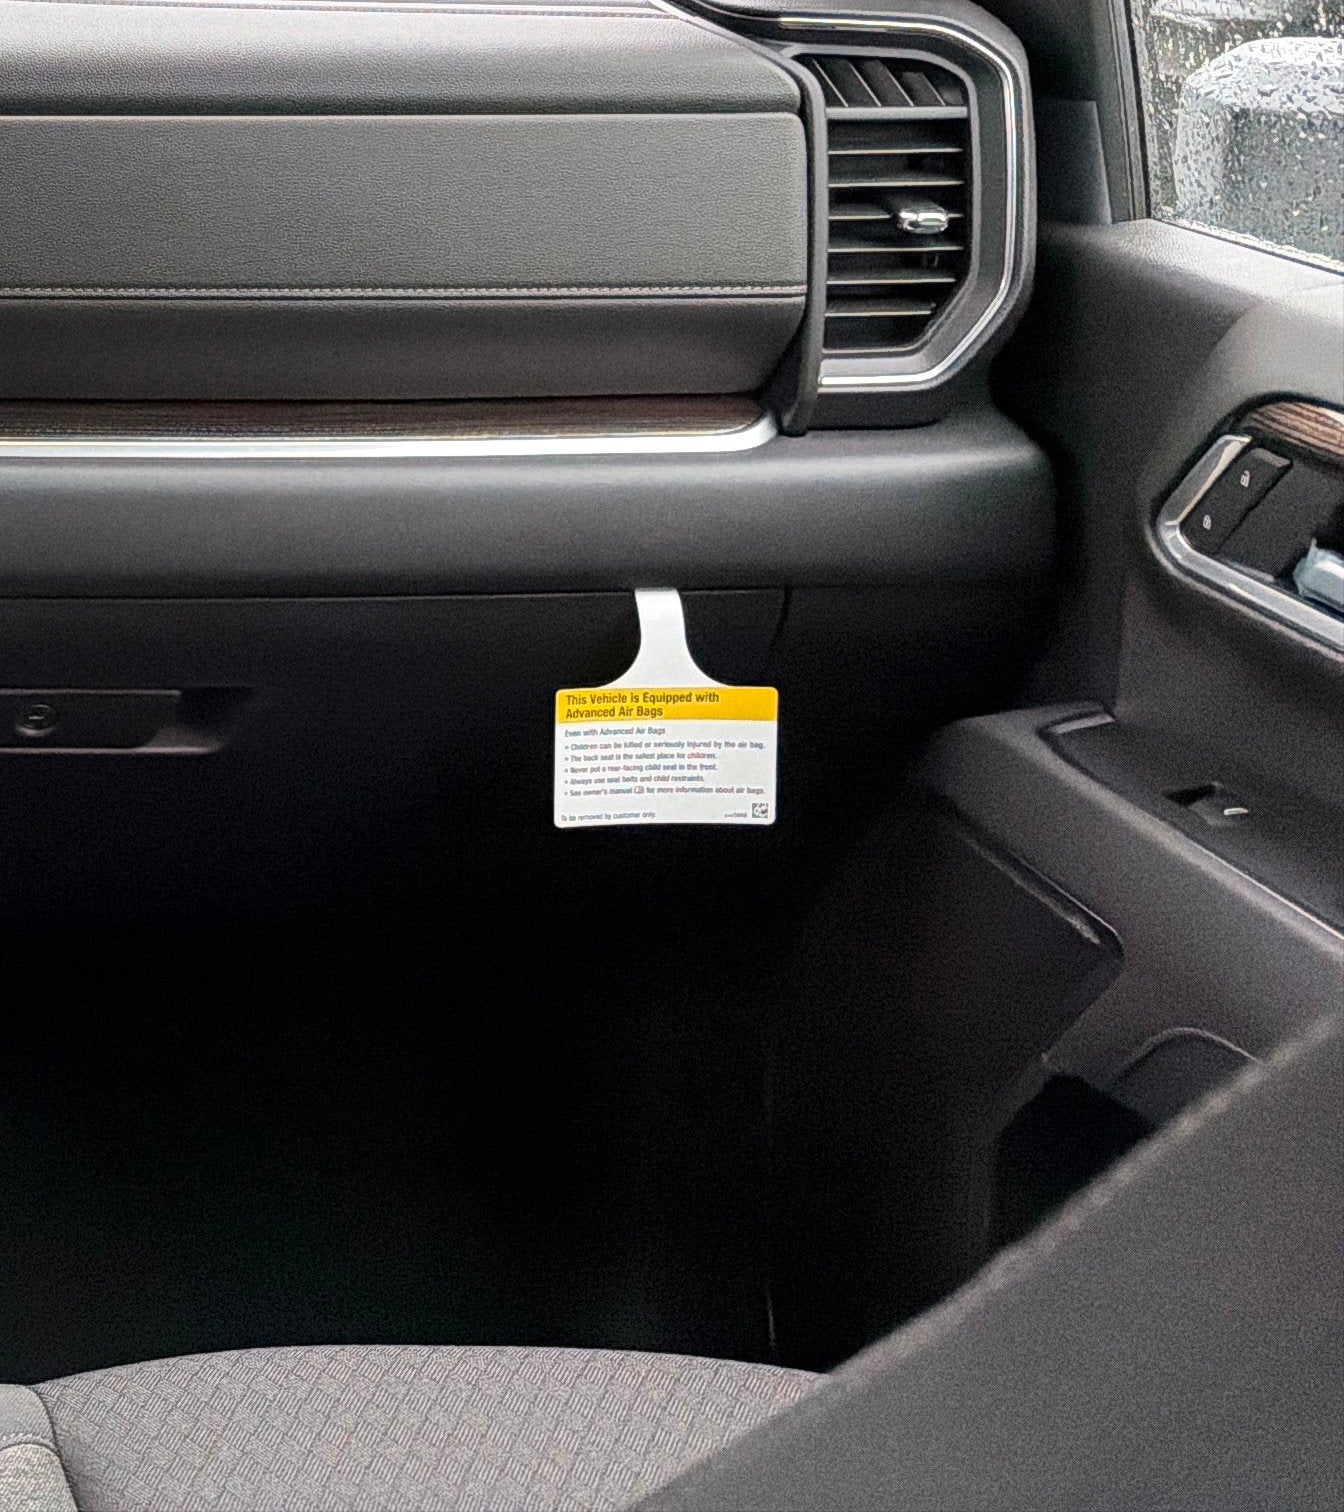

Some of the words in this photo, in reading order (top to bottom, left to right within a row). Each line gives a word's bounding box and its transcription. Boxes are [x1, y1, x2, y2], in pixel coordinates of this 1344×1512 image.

[566, 694, 587, 706] This
[590, 692, 628, 705] Vehicle
[642, 692, 693, 706] Equipped
[695, 692, 720, 703] with
[566, 706, 616, 719] Advanced
[618, 706, 634, 717] Air
[636, 705, 664, 718] Bags
[564, 730, 582, 738] Even
[582, 728, 598, 736] with
[599, 728, 634, 736] Advanced
[635, 727, 646, 735] Air
[648, 726, 666, 736] Bags
[653, 741, 685, 750] seriously
[686, 740, 712, 750] injured
[713, 740, 722, 750] by
[724, 740, 736, 748] the
[583, 754, 599, 762] back
[634, 752, 656, 760] safest
[656, 752, 675, 760] place
[570, 766, 588, 774] Never
[608, 764, 644, 772] rear-facing
[570, 778, 592, 786] Always
[606, 776, 620, 784] seat
[654, 774, 670, 782] child
[570, 789, 582, 797] See
[582, 788, 608, 796] owner's
[646, 786, 655, 794] for
[675, 786, 714, 794] information
[714, 786, 735, 794] about
[736, 786, 746, 794] air
[568, 814, 576, 822] be
[578, 813, 604, 821] removed
[604, 812, 612, 820] by
[612, 812, 641, 820] customer
